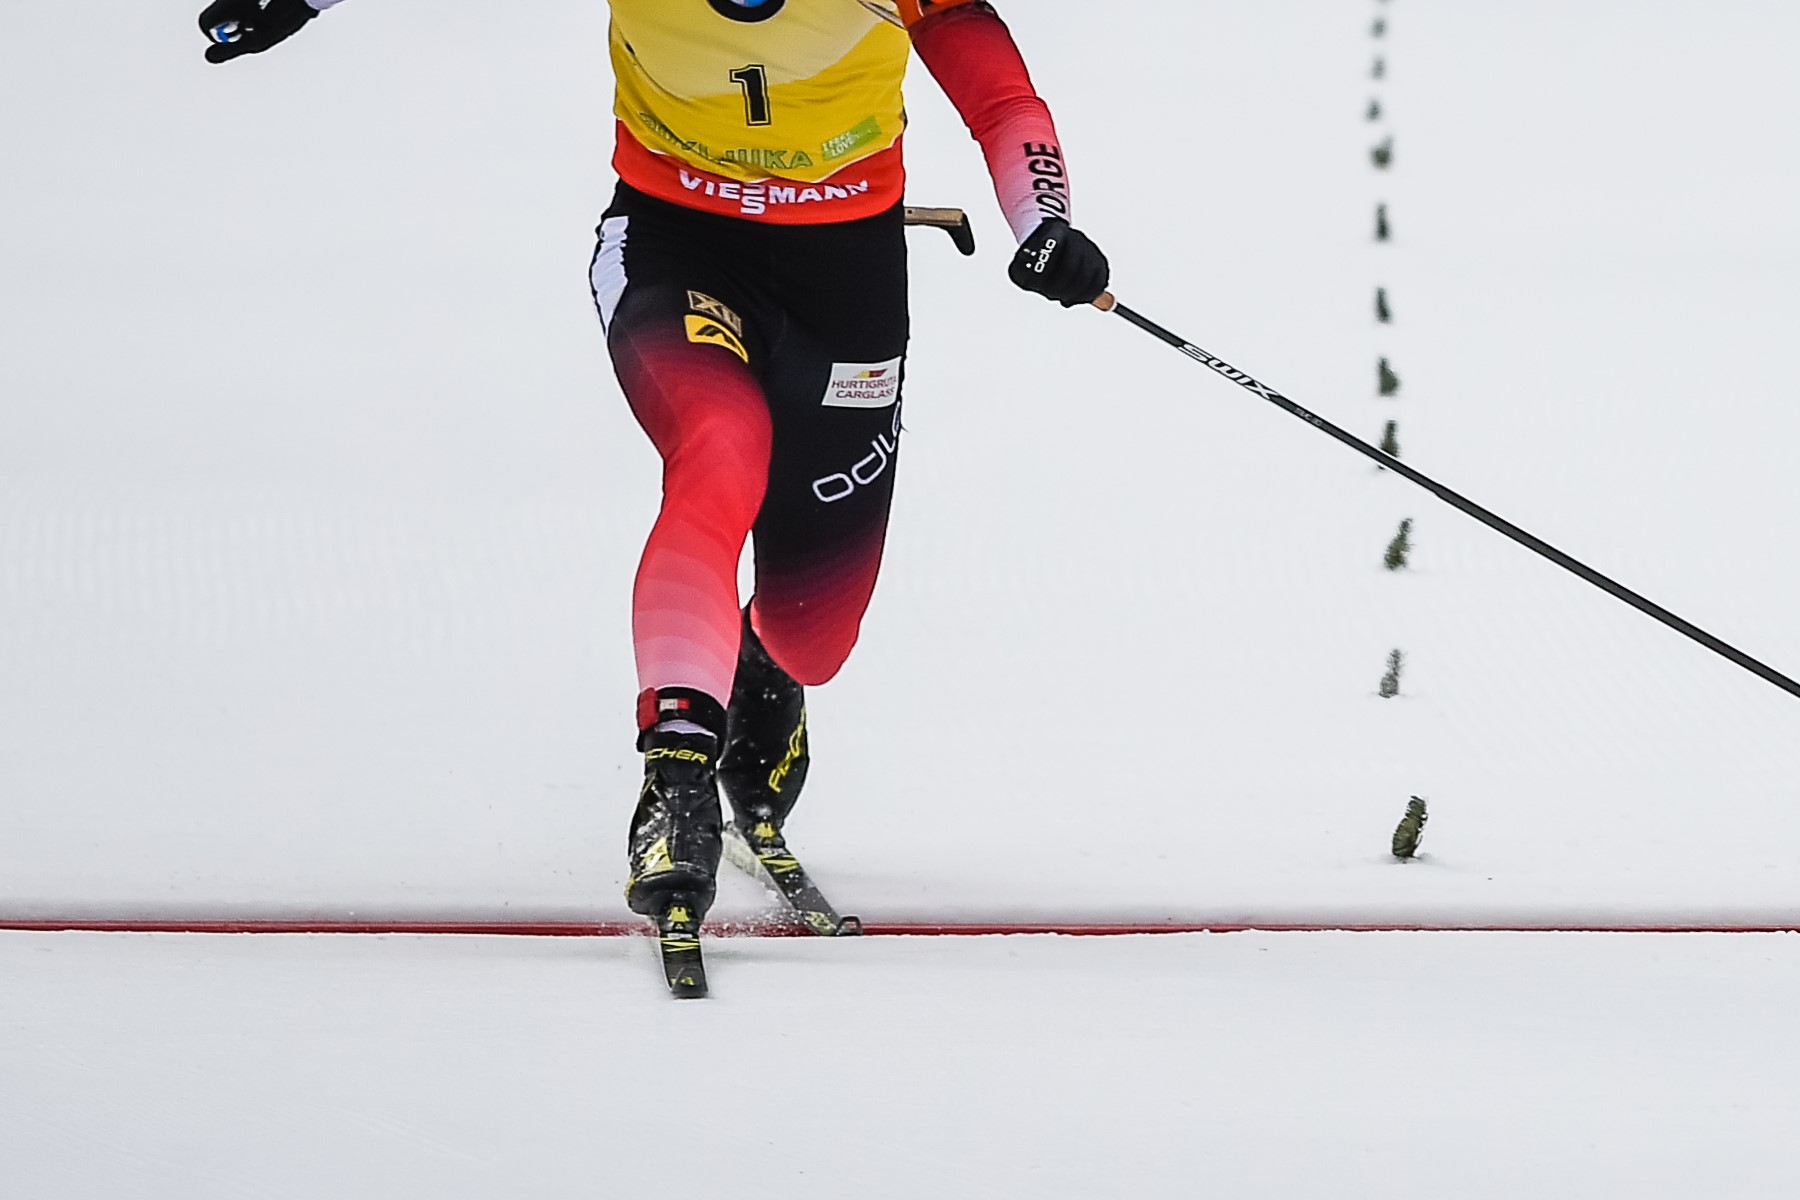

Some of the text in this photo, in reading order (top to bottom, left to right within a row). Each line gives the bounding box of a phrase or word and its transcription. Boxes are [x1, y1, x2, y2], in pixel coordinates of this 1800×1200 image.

[729, 63, 772, 127] 1
[678, 169, 869, 215] VIESSMANN
[1034, 238, 1057, 273] odlo
